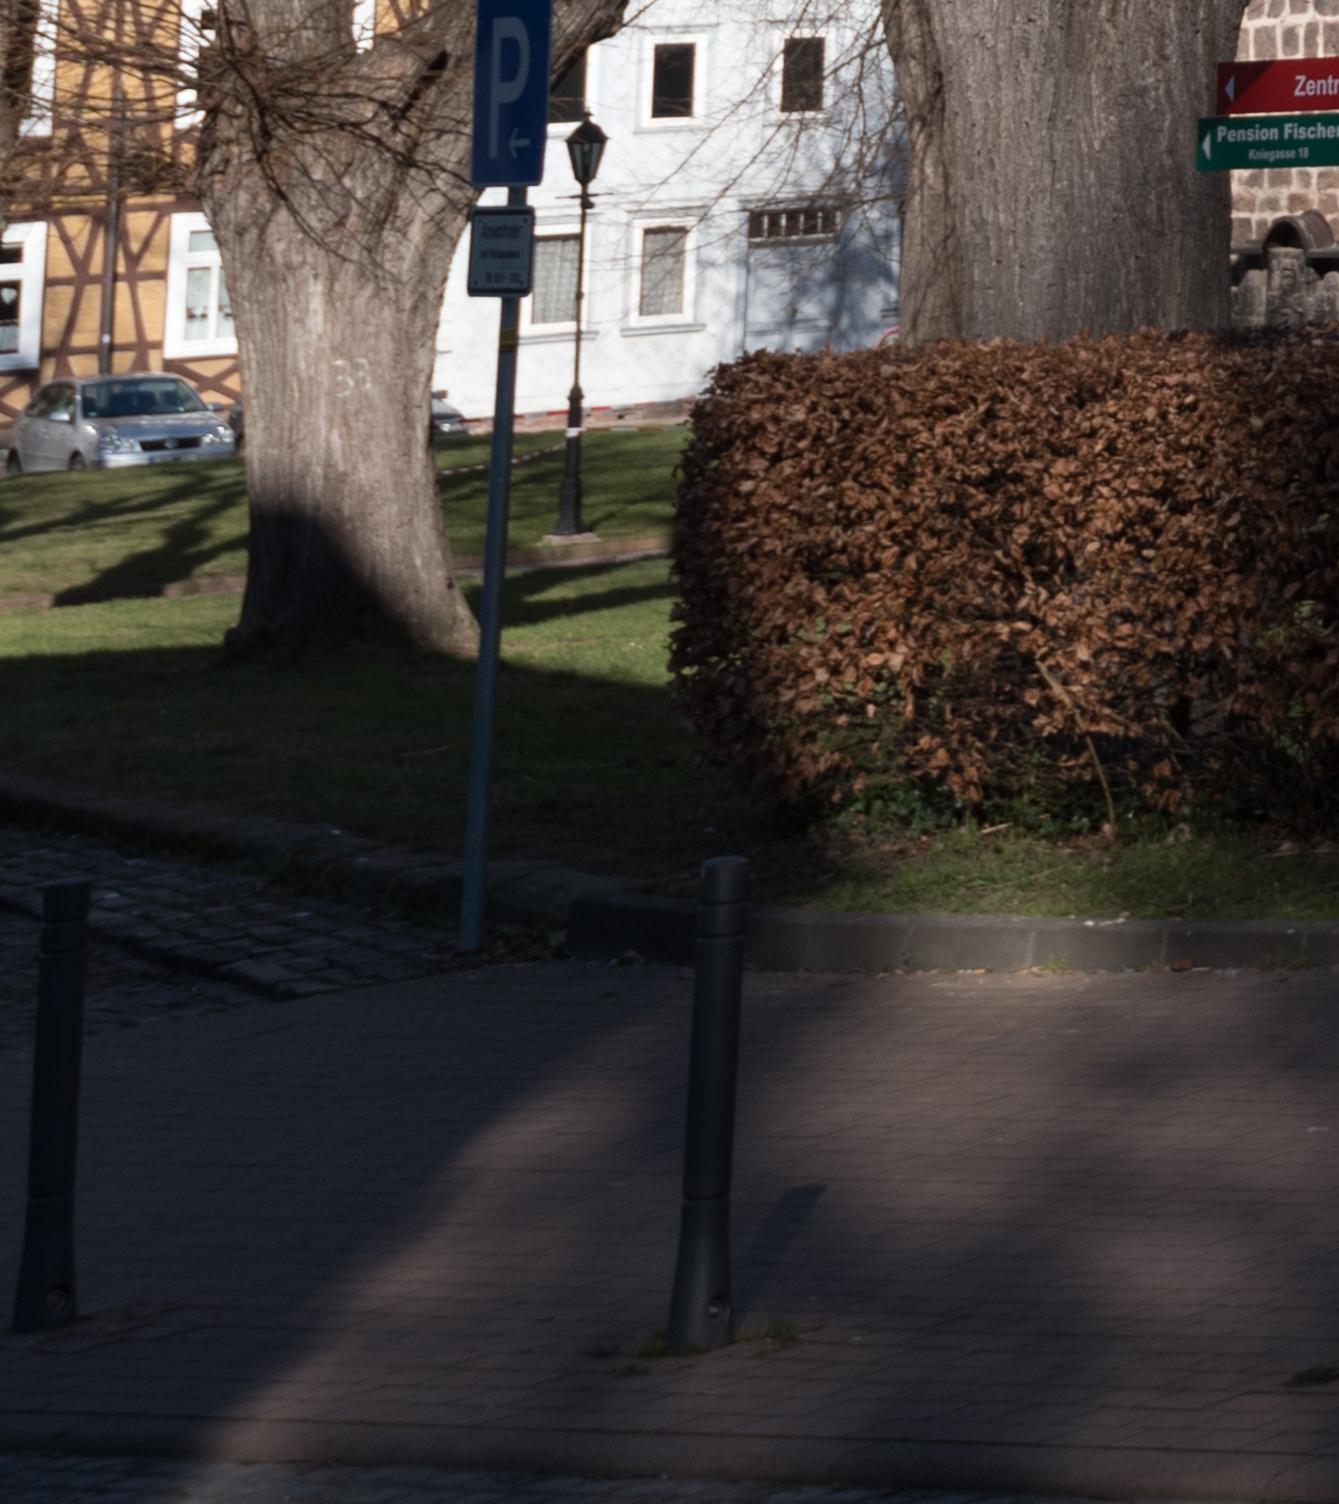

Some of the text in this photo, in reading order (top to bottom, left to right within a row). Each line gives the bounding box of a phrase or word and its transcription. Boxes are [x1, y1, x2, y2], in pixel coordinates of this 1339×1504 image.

[488, 16, 531, 159] P
[1216, 124, 1279, 143] Pension
[1248, 146, 1310, 163] Kniegasse 18
